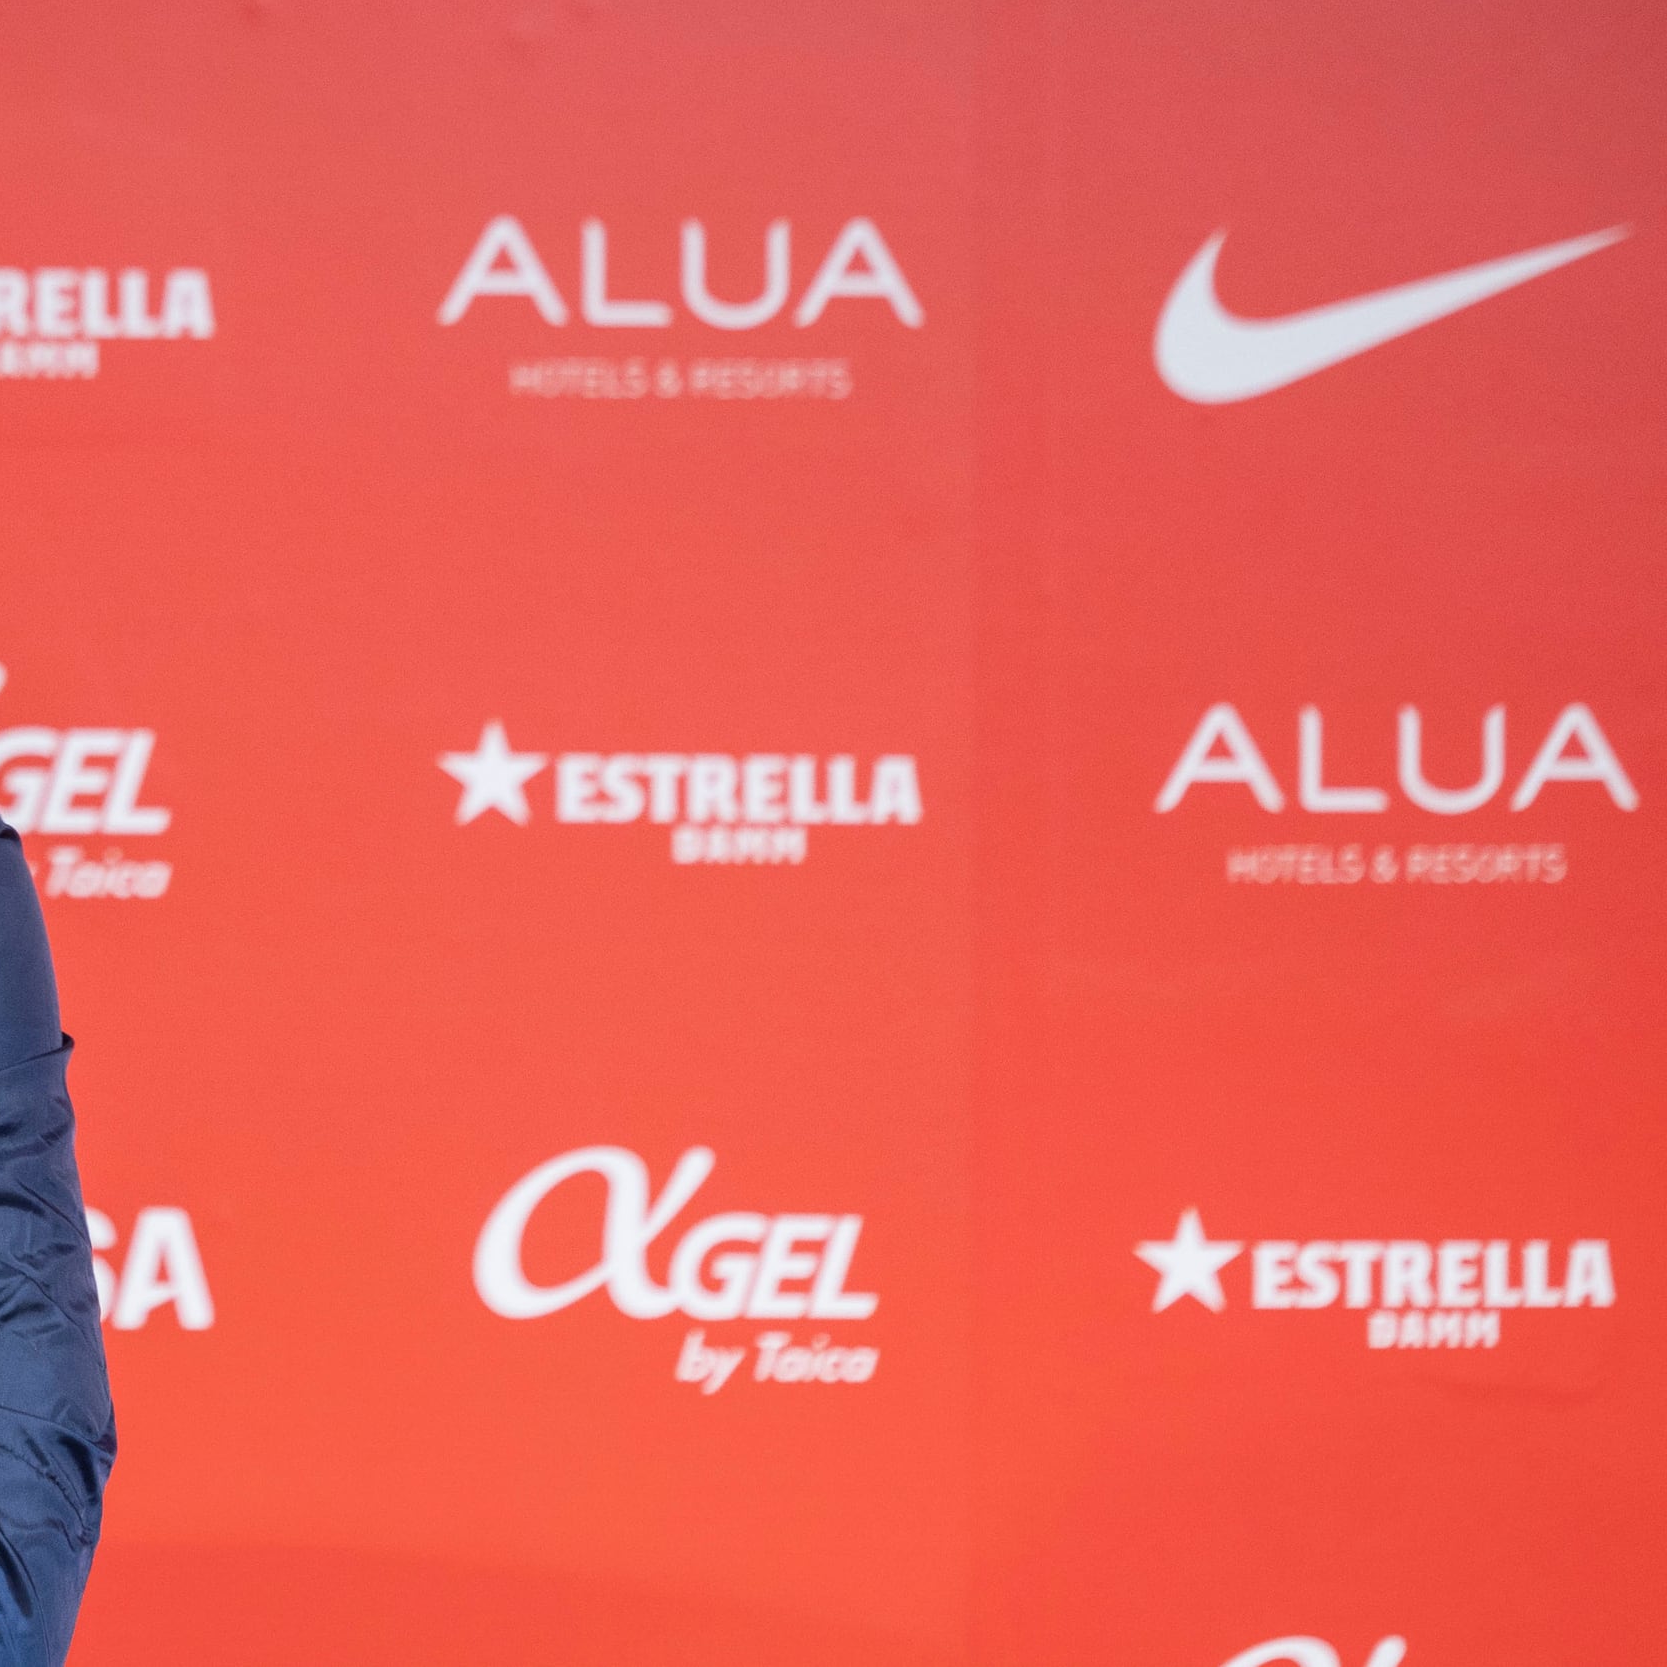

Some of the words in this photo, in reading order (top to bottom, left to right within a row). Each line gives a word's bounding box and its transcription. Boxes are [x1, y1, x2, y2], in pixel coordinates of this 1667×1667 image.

[439, 217, 922, 329] ALUA
[557, 754, 921, 825] ESTRELLA
[1156, 704, 1637, 814] ALUA
[47, 846, 172, 899] Taica
[1253, 1241, 1614, 1308] ESTRELLA
[676, 1331, 744, 1394] by
[755, 1332, 879, 1382] Taica
